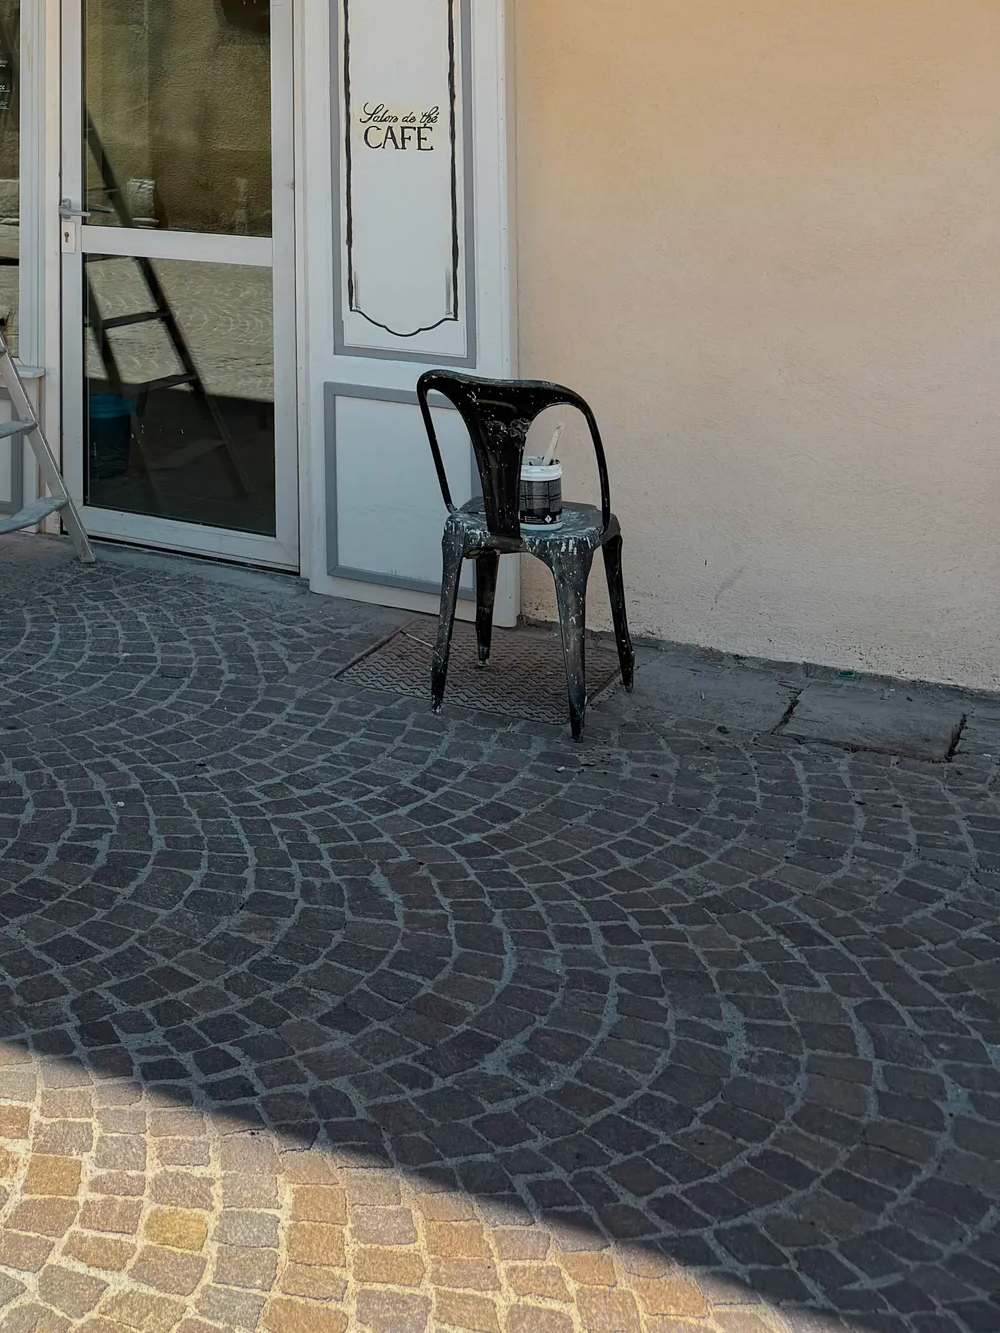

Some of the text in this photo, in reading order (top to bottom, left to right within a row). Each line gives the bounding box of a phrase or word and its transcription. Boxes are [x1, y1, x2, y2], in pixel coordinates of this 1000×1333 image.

[359, 102, 440, 124] Salon de thé
[363, 123, 434, 151] CAFÉ
